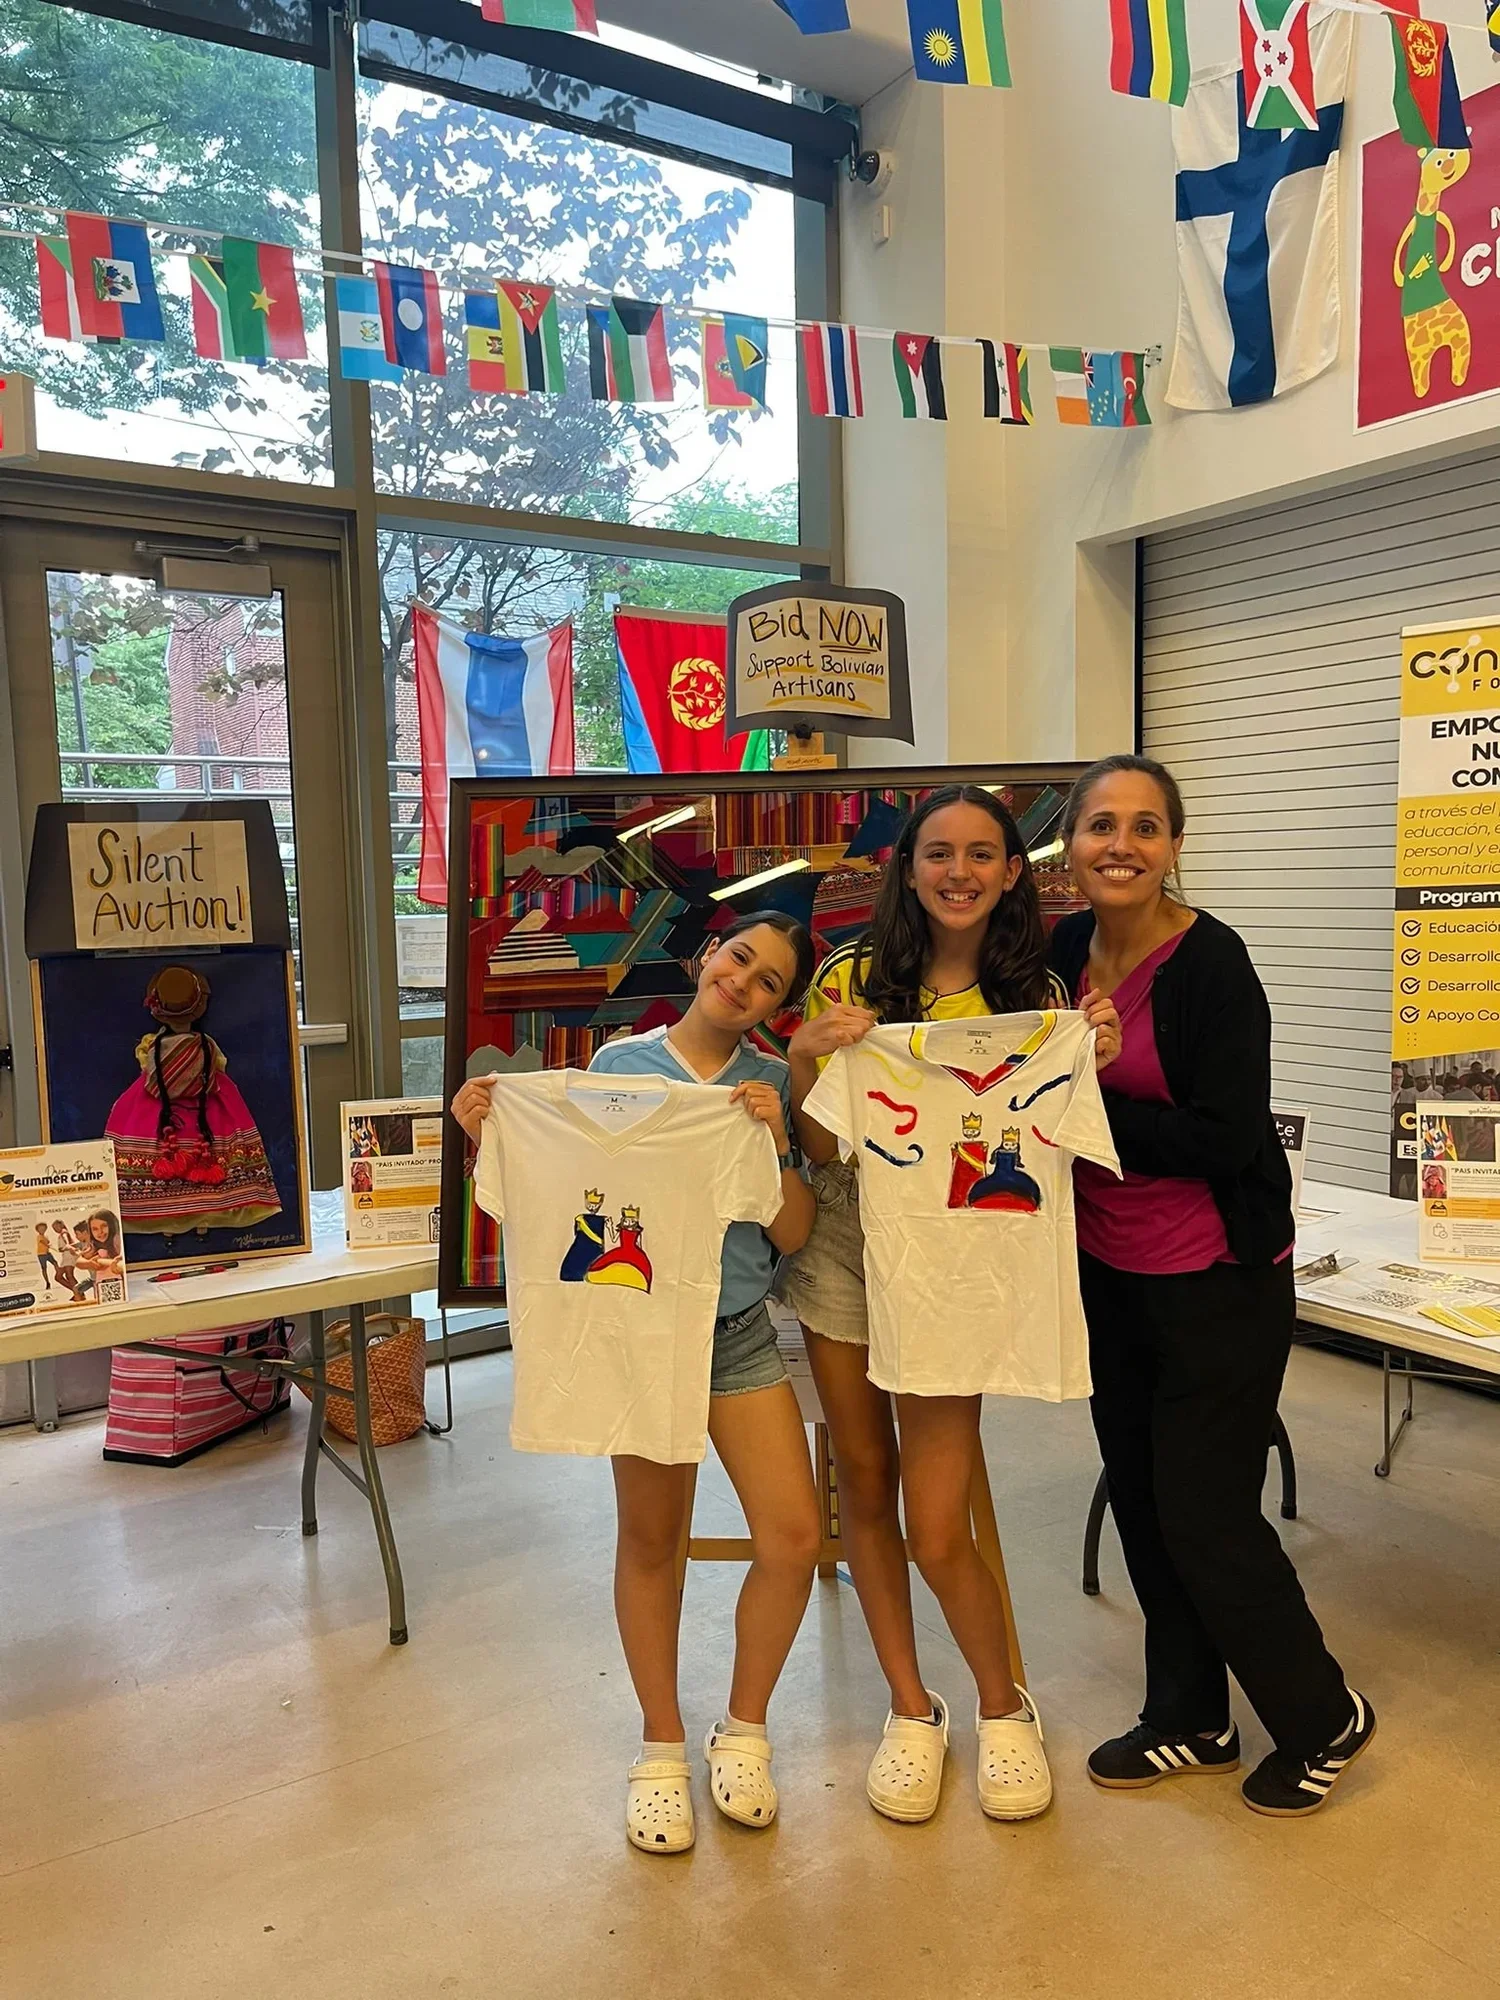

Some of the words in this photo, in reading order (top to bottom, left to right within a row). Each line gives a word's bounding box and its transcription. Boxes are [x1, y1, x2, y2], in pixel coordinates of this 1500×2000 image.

[749, 601, 810, 642] Bid
[819, 606, 883, 651] NOW
[747, 650, 814, 679] Support
[821, 655, 884, 676] Bolivian
[772, 675, 856, 701] Artisans
[1405, 809, 1416, 819] a
[1419, 804, 1468, 818] través
[1470, 802, 1496, 816] del
[1404, 822, 1491, 838] educación,
[90, 828, 204, 888] Silent
[1403, 842, 1474, 860] personal
[1474, 844, 1487, 858] y
[93, 885, 246, 937] Auction!
[1429, 921, 1500, 934] Educació
[1426, 1009, 1475, 1023] Apoyo
